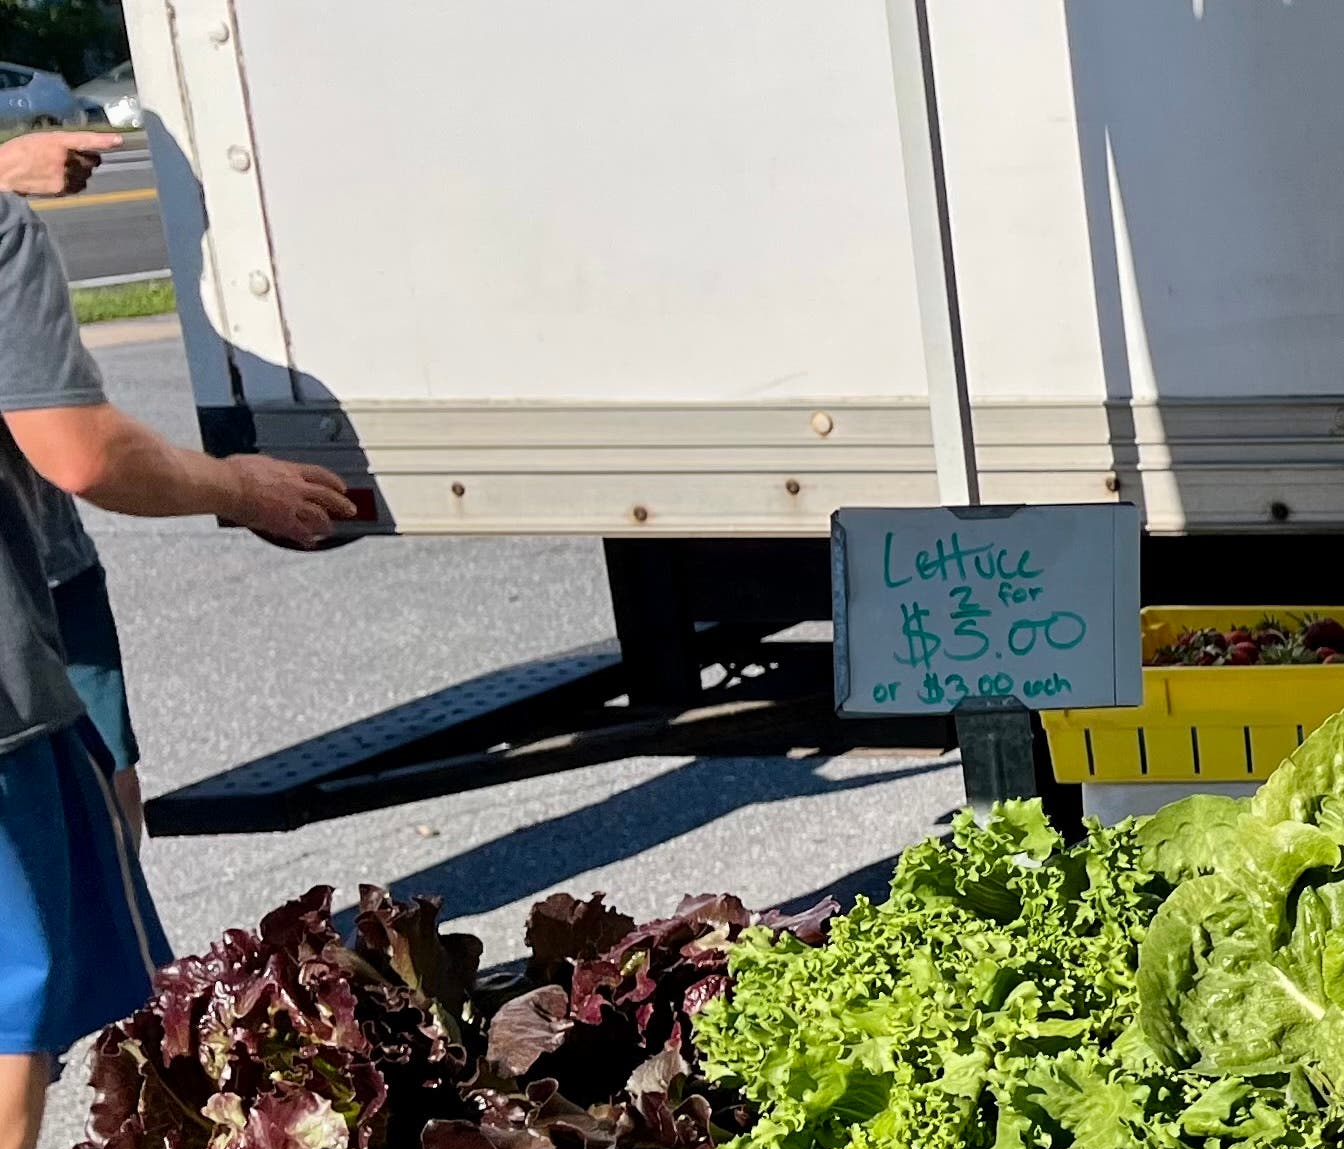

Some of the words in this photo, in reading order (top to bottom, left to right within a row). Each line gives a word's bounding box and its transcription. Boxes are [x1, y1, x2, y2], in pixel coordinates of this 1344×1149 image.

[883, 531, 1044, 588] Lettuce
[949, 585, 981, 610] 2
[998, 582, 1044, 609] for
[893, 600, 1087, 668] $5.00
[872, 680, 902, 704] or
[1022, 673, 1072, 698] each
